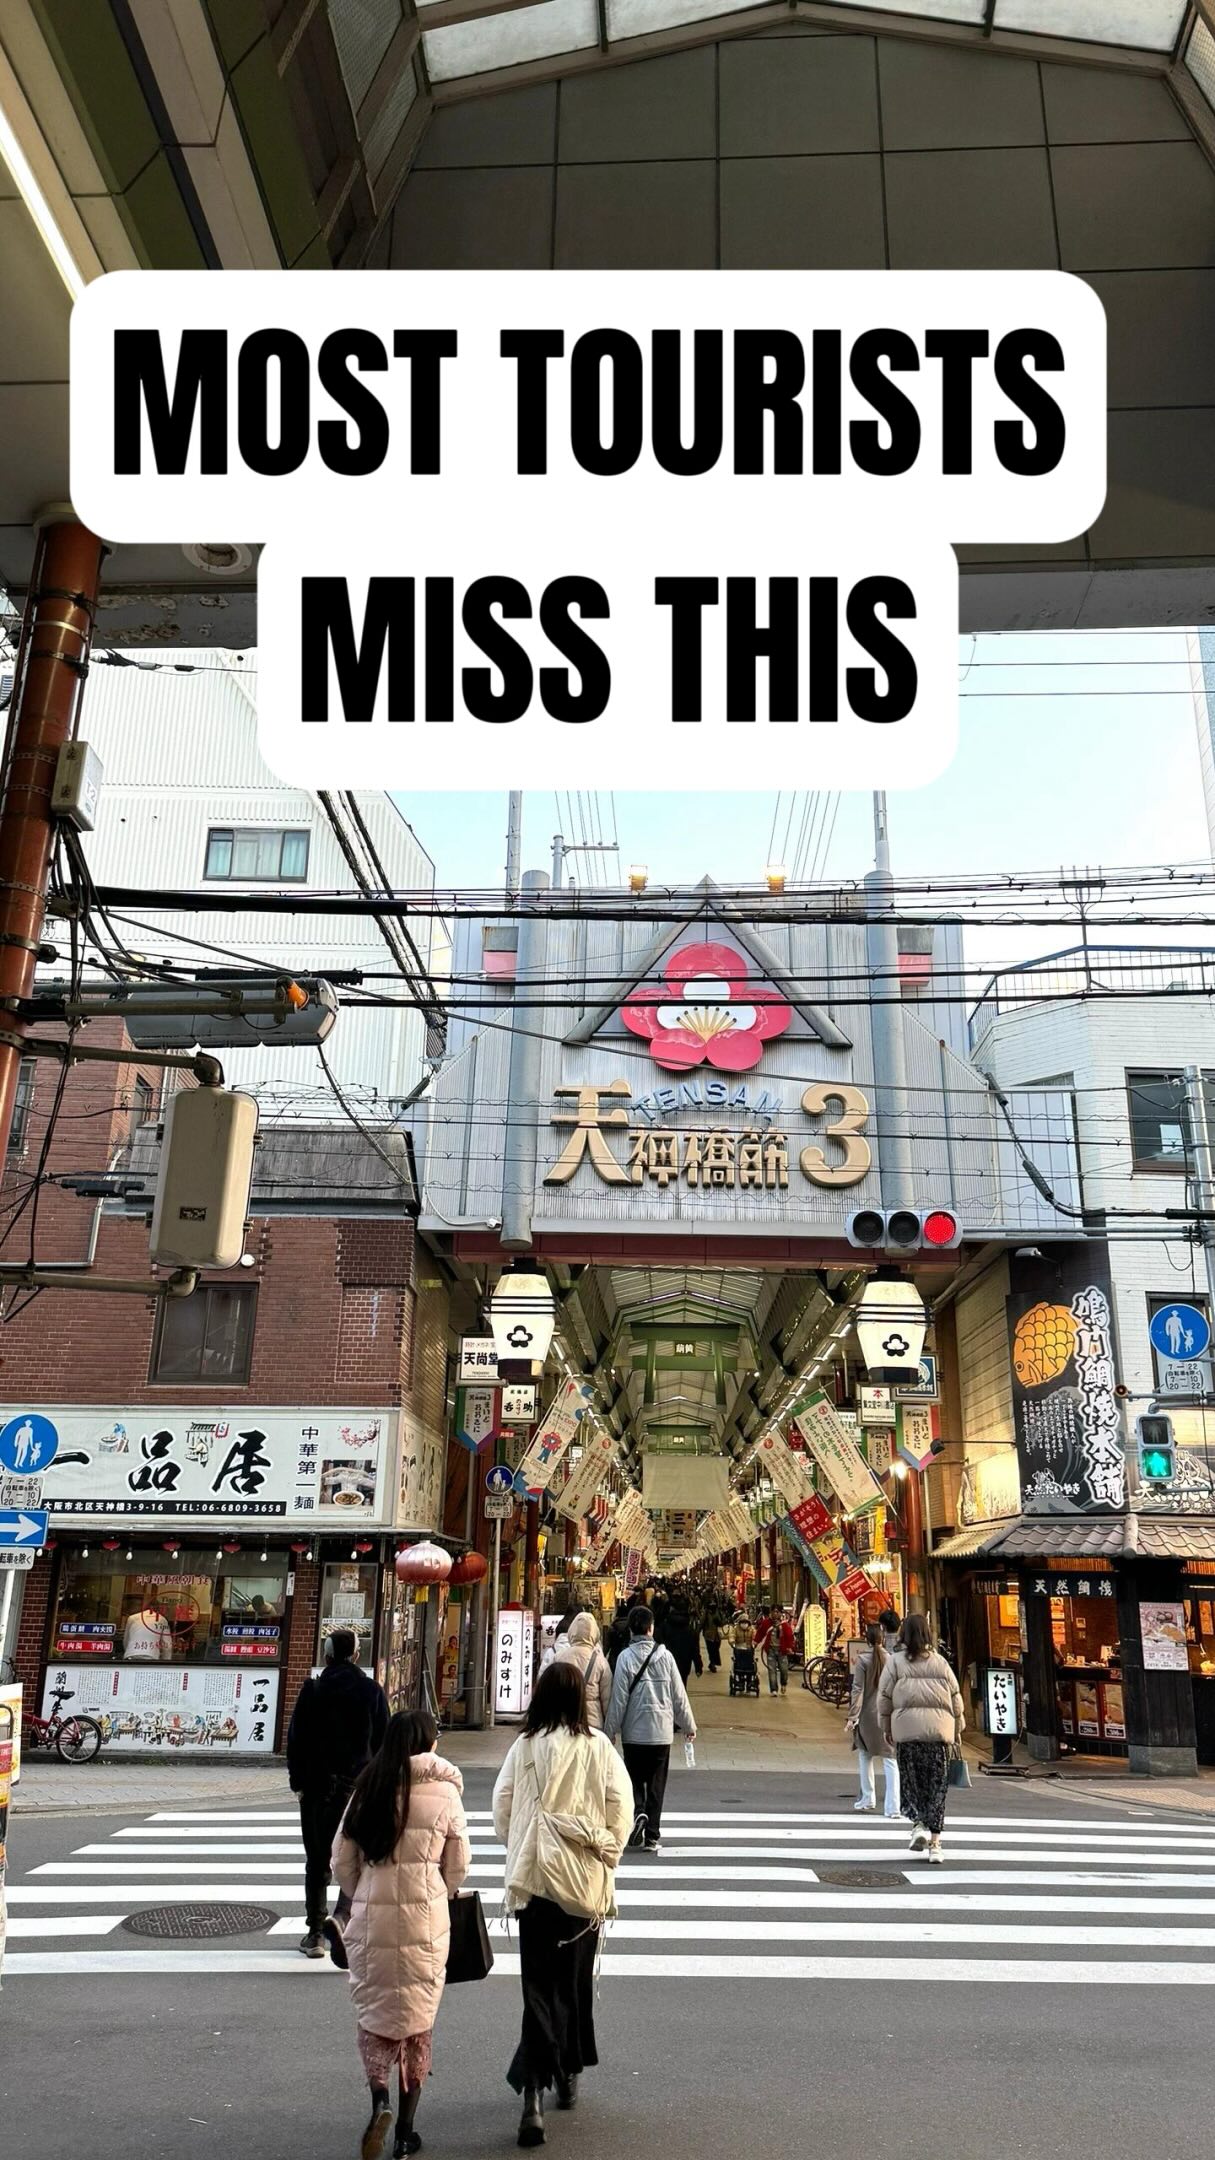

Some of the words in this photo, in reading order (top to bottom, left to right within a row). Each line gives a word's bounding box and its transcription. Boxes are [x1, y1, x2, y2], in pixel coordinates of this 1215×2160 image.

[501, 1634, 513, 1698] のみすけ
[248, 1678, 270, 1742] 一品居
[993, 1674, 1007, 1732] たいやき
